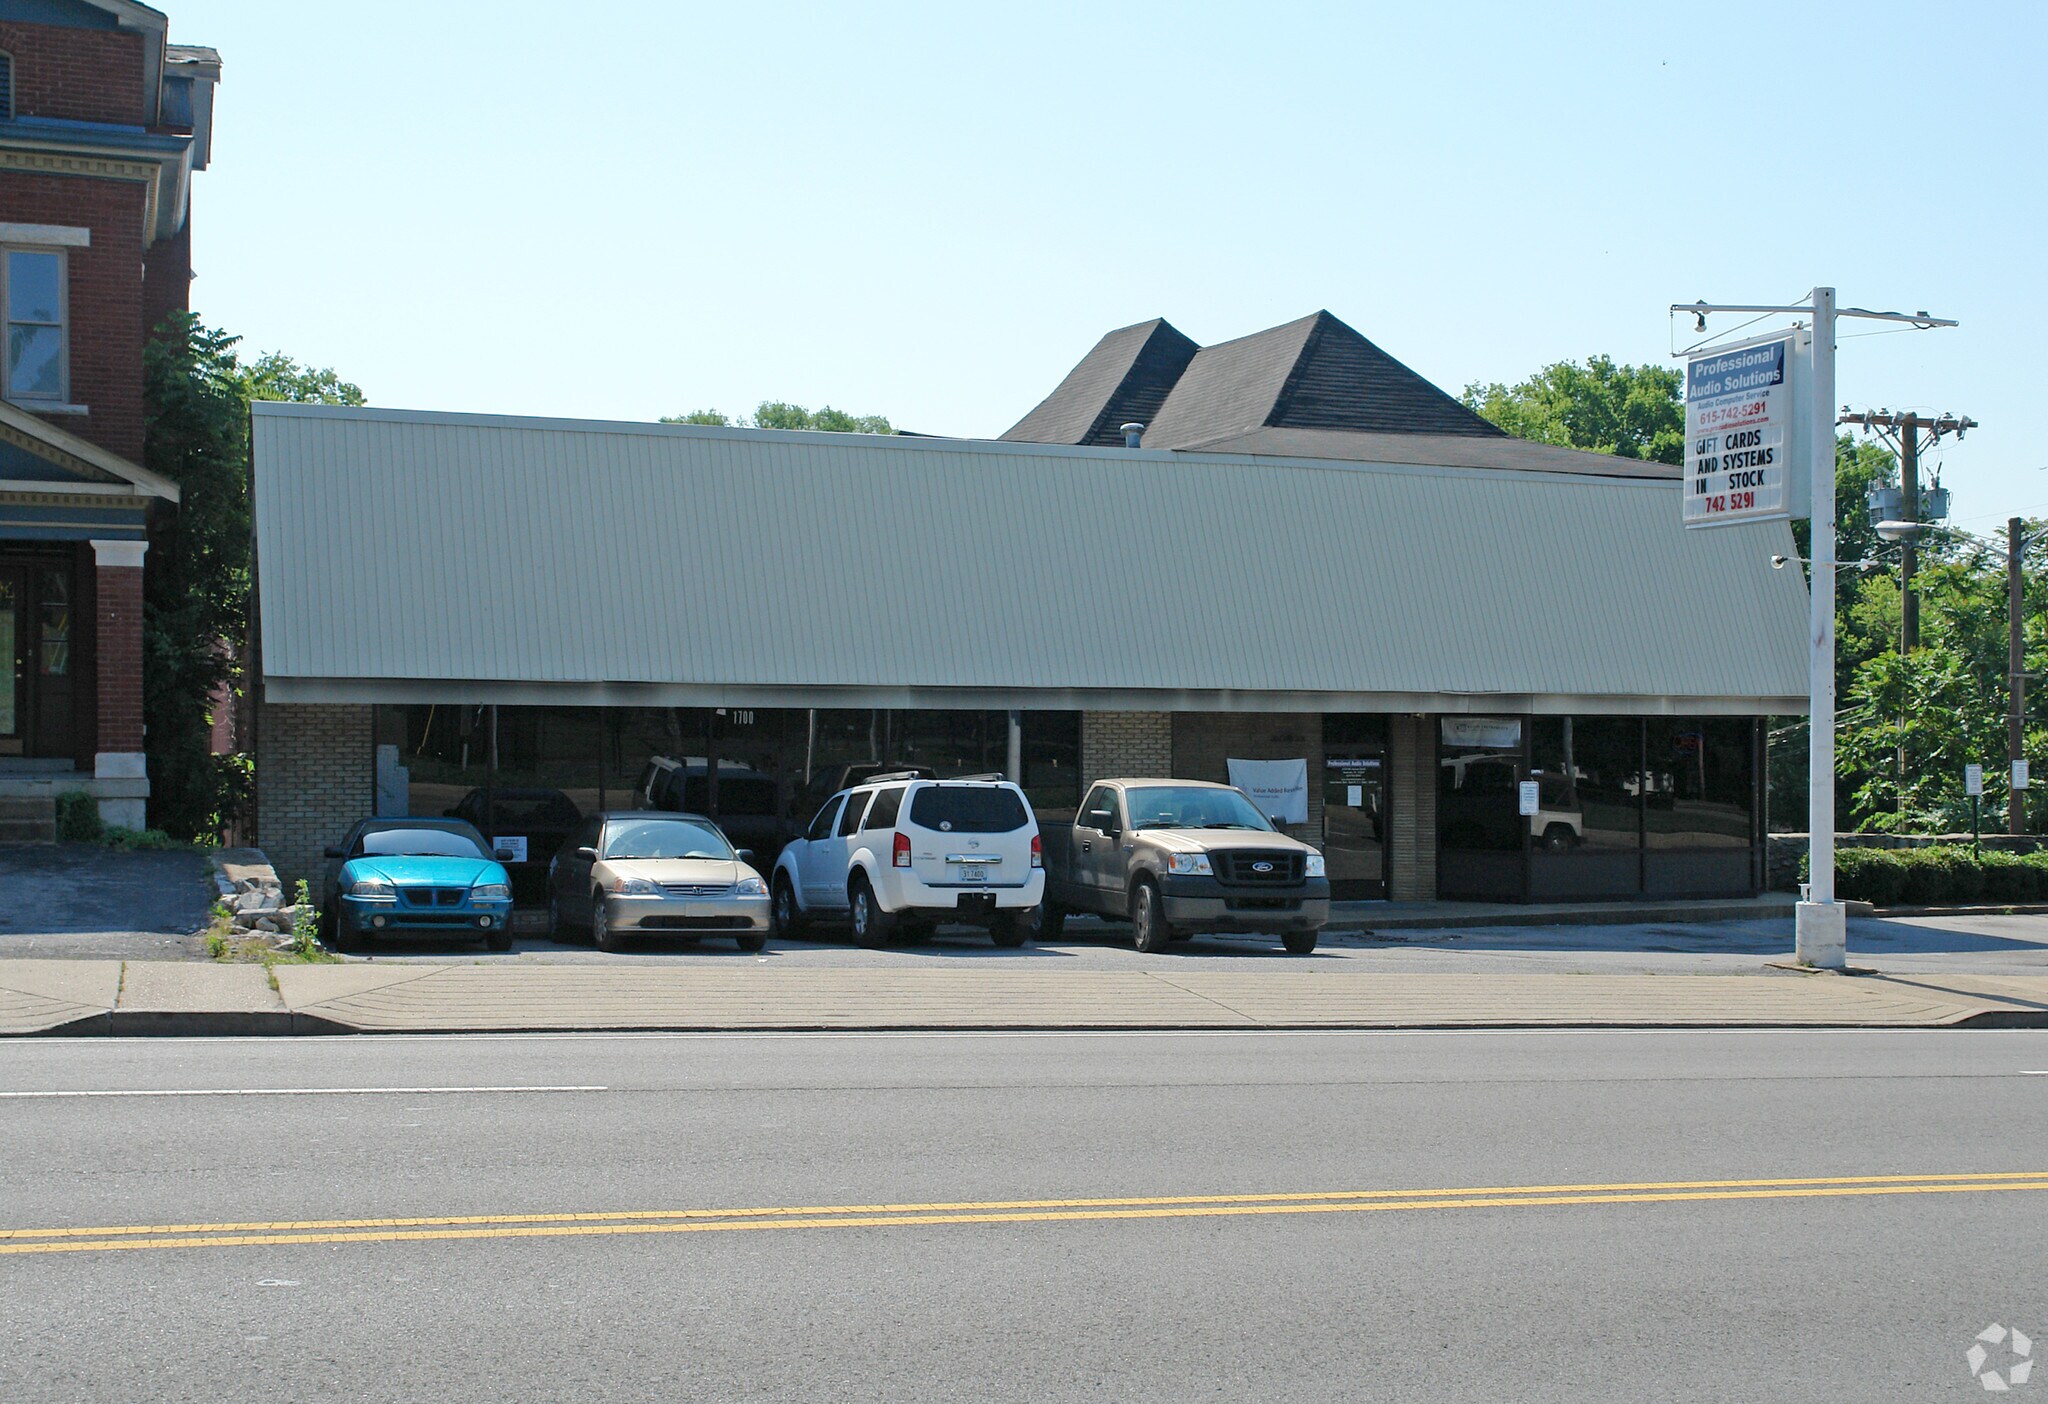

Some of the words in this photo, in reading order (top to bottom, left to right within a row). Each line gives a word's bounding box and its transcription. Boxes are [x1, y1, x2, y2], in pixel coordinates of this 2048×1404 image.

[1695, 346, 1775, 378] Professional
[1689, 380, 1722, 399] Audio
[1724, 369, 1781, 391] Solutions
[1715, 394, 1745, 407] Computer
[1746, 390, 1770, 400] Service
[1700, 401, 1766, 425] 615-742-5291
[1696, 437, 1718, 455] GIFT
[1725, 429, 1761, 450] CARDS
[1697, 457, 1718, 475] AND
[1723, 447, 1774, 471] SYSTEMS
[1696, 478, 1707, 495] IN
[1729, 469, 1765, 490] STOCK
[1705, 495, 1725, 513] 742
[1730, 491, 1755, 510] 5291
[733, 710, 754, 725] 1700
